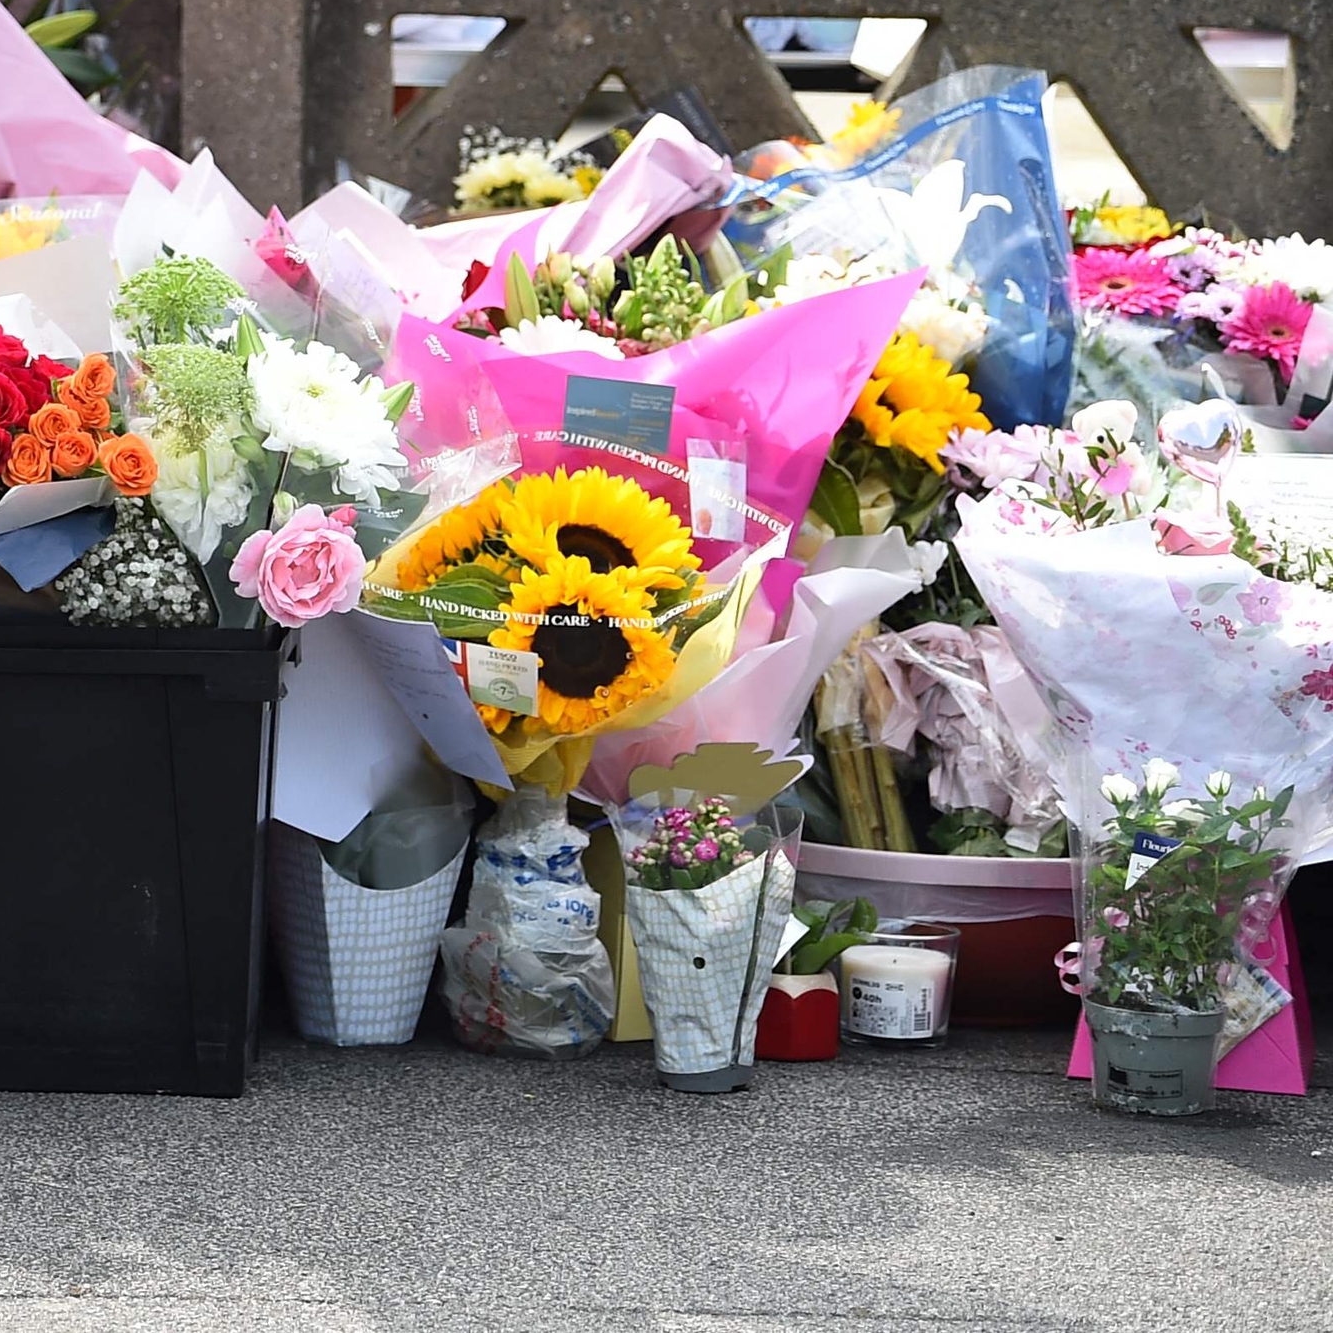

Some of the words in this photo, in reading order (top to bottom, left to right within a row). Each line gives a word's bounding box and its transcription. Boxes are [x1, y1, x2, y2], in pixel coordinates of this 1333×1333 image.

[368, 581, 404, 601] CARE
[419, 595, 459, 615] HAND
[459, 604, 511, 622] PICKED
[512, 612, 550, 626] WITH
[551, 615, 590, 627] CARE
[608, 617, 653, 629] HAND
[499, 685, 507, 696] 7
